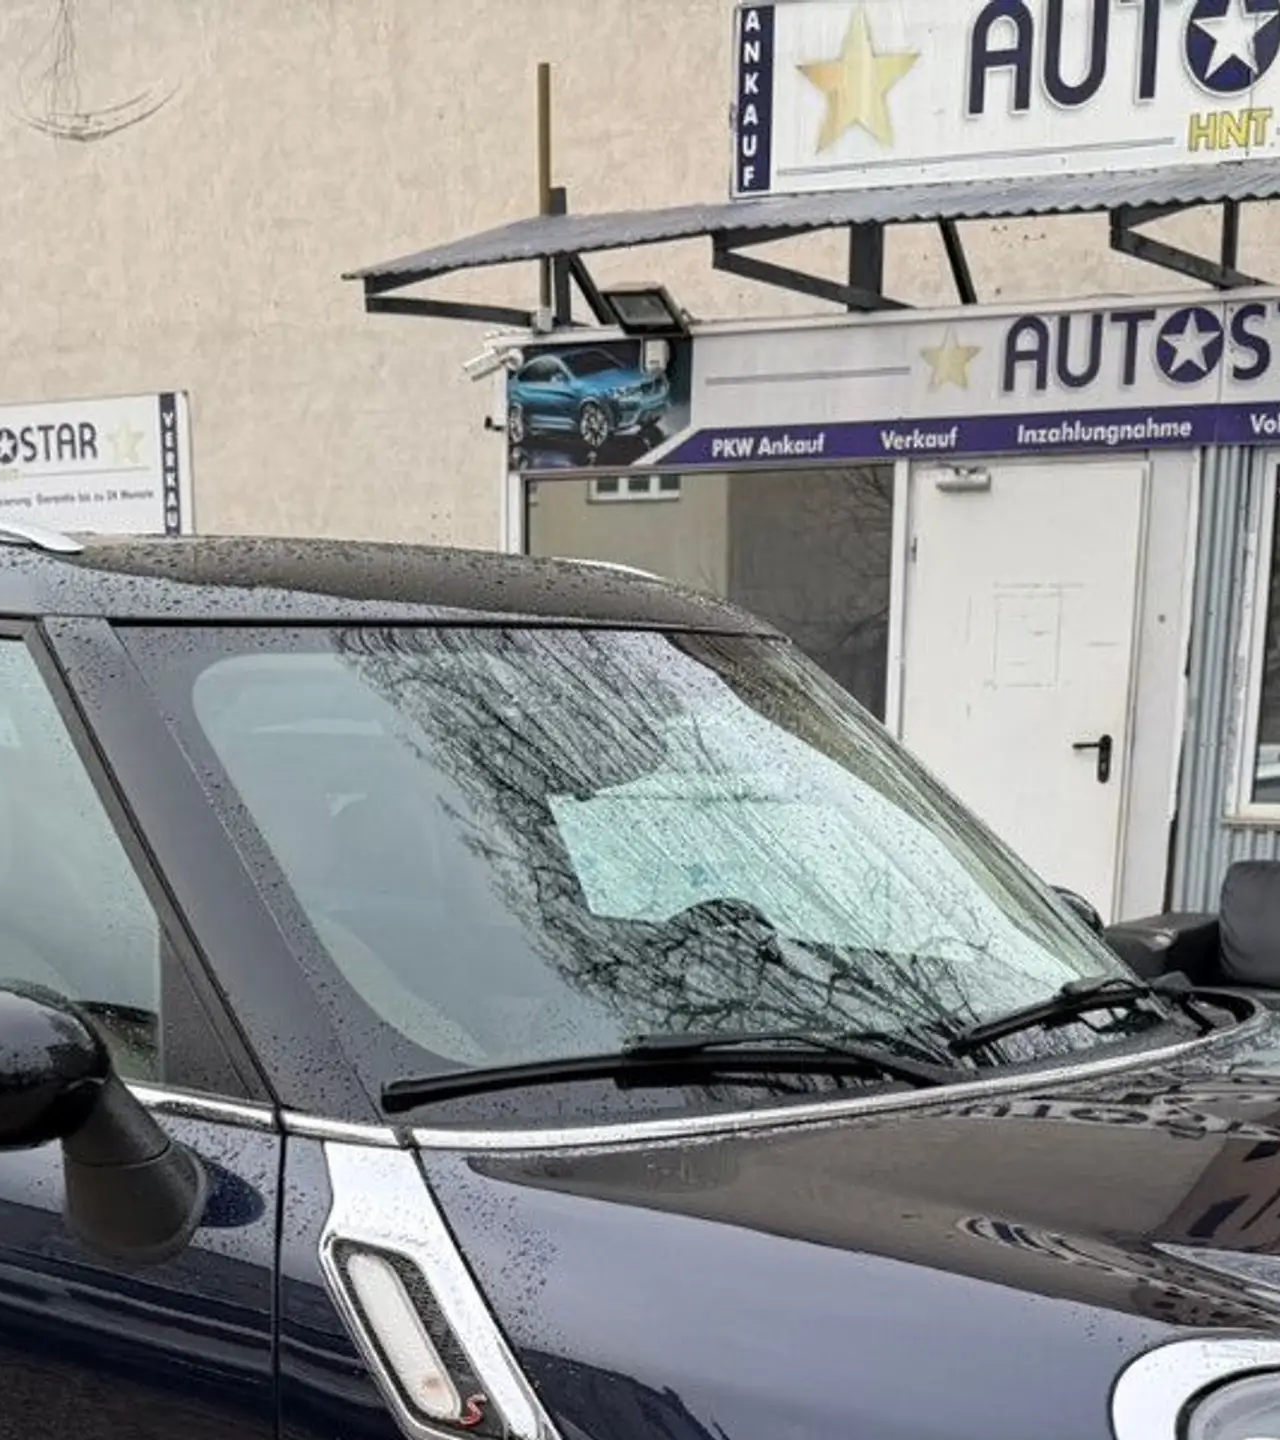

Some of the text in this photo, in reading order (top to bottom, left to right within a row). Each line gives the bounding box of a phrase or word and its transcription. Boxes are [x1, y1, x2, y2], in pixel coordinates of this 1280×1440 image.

[741, 8, 762, 189] ANKAUF
[1187, 107, 1273, 153] HNT
[162, 411, 178, 528] VERKAU
[711, 437, 754, 458] PKW
[757, 432, 826, 456] Ankauf
[880, 426, 959, 450] Verkauf
[1016, 417, 1193, 446] Inzahlungnahme
